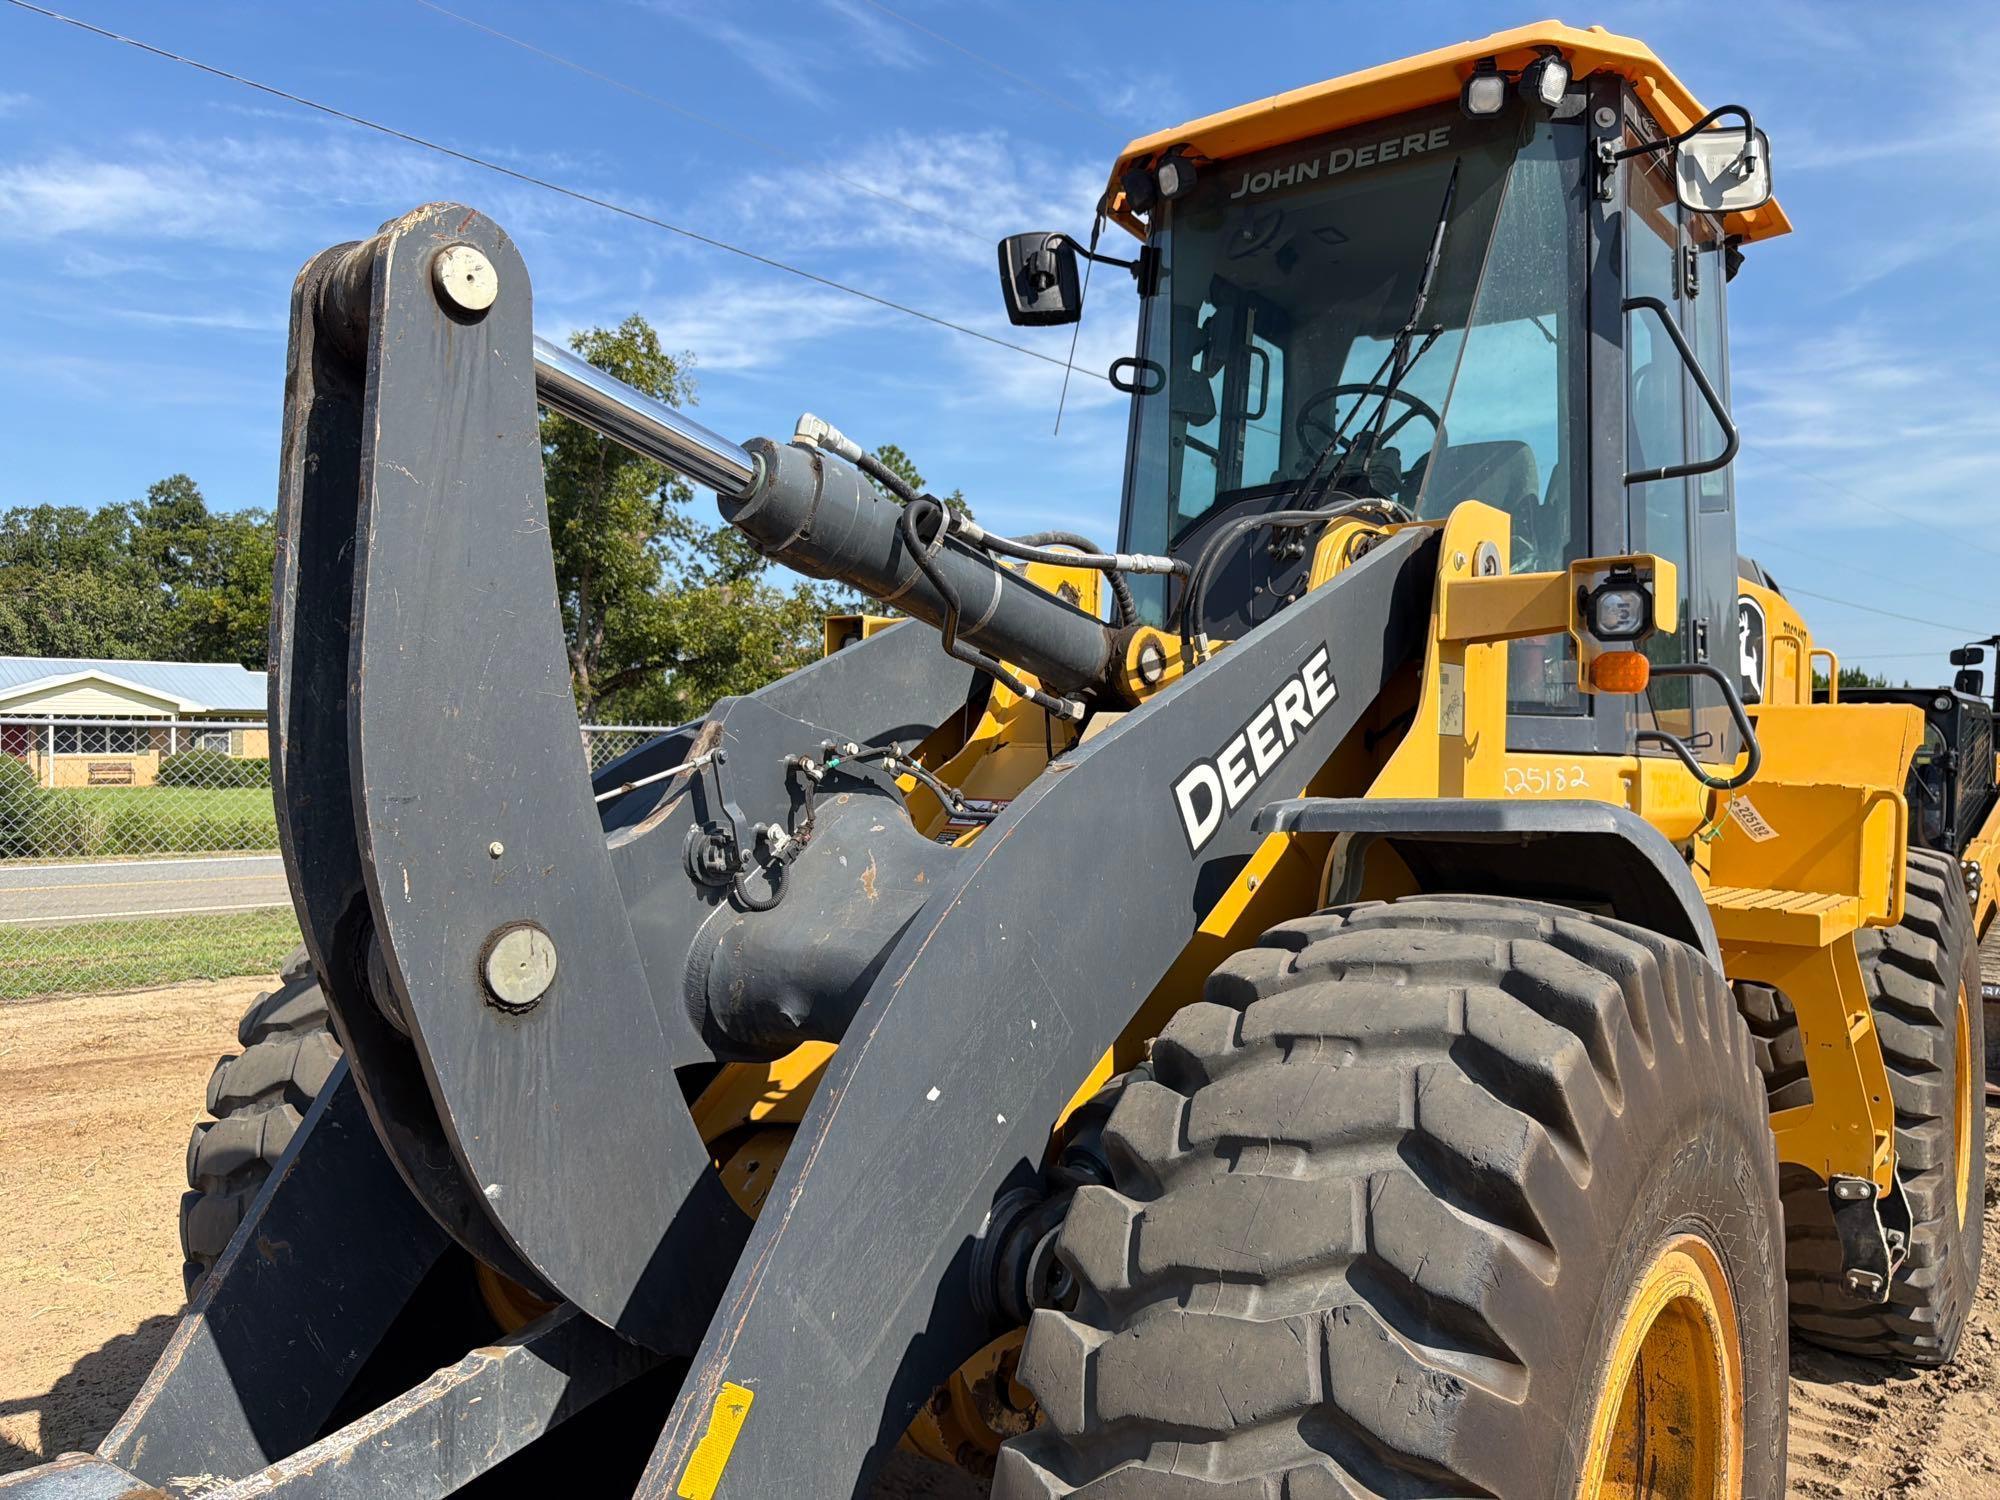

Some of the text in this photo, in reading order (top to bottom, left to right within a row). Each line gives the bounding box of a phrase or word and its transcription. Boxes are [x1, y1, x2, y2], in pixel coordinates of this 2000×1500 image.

[1230, 126, 1451, 199] JOHN DEERE
[1175, 647, 1337, 850] DEERE
[1738, 806, 1770, 836] 225182
